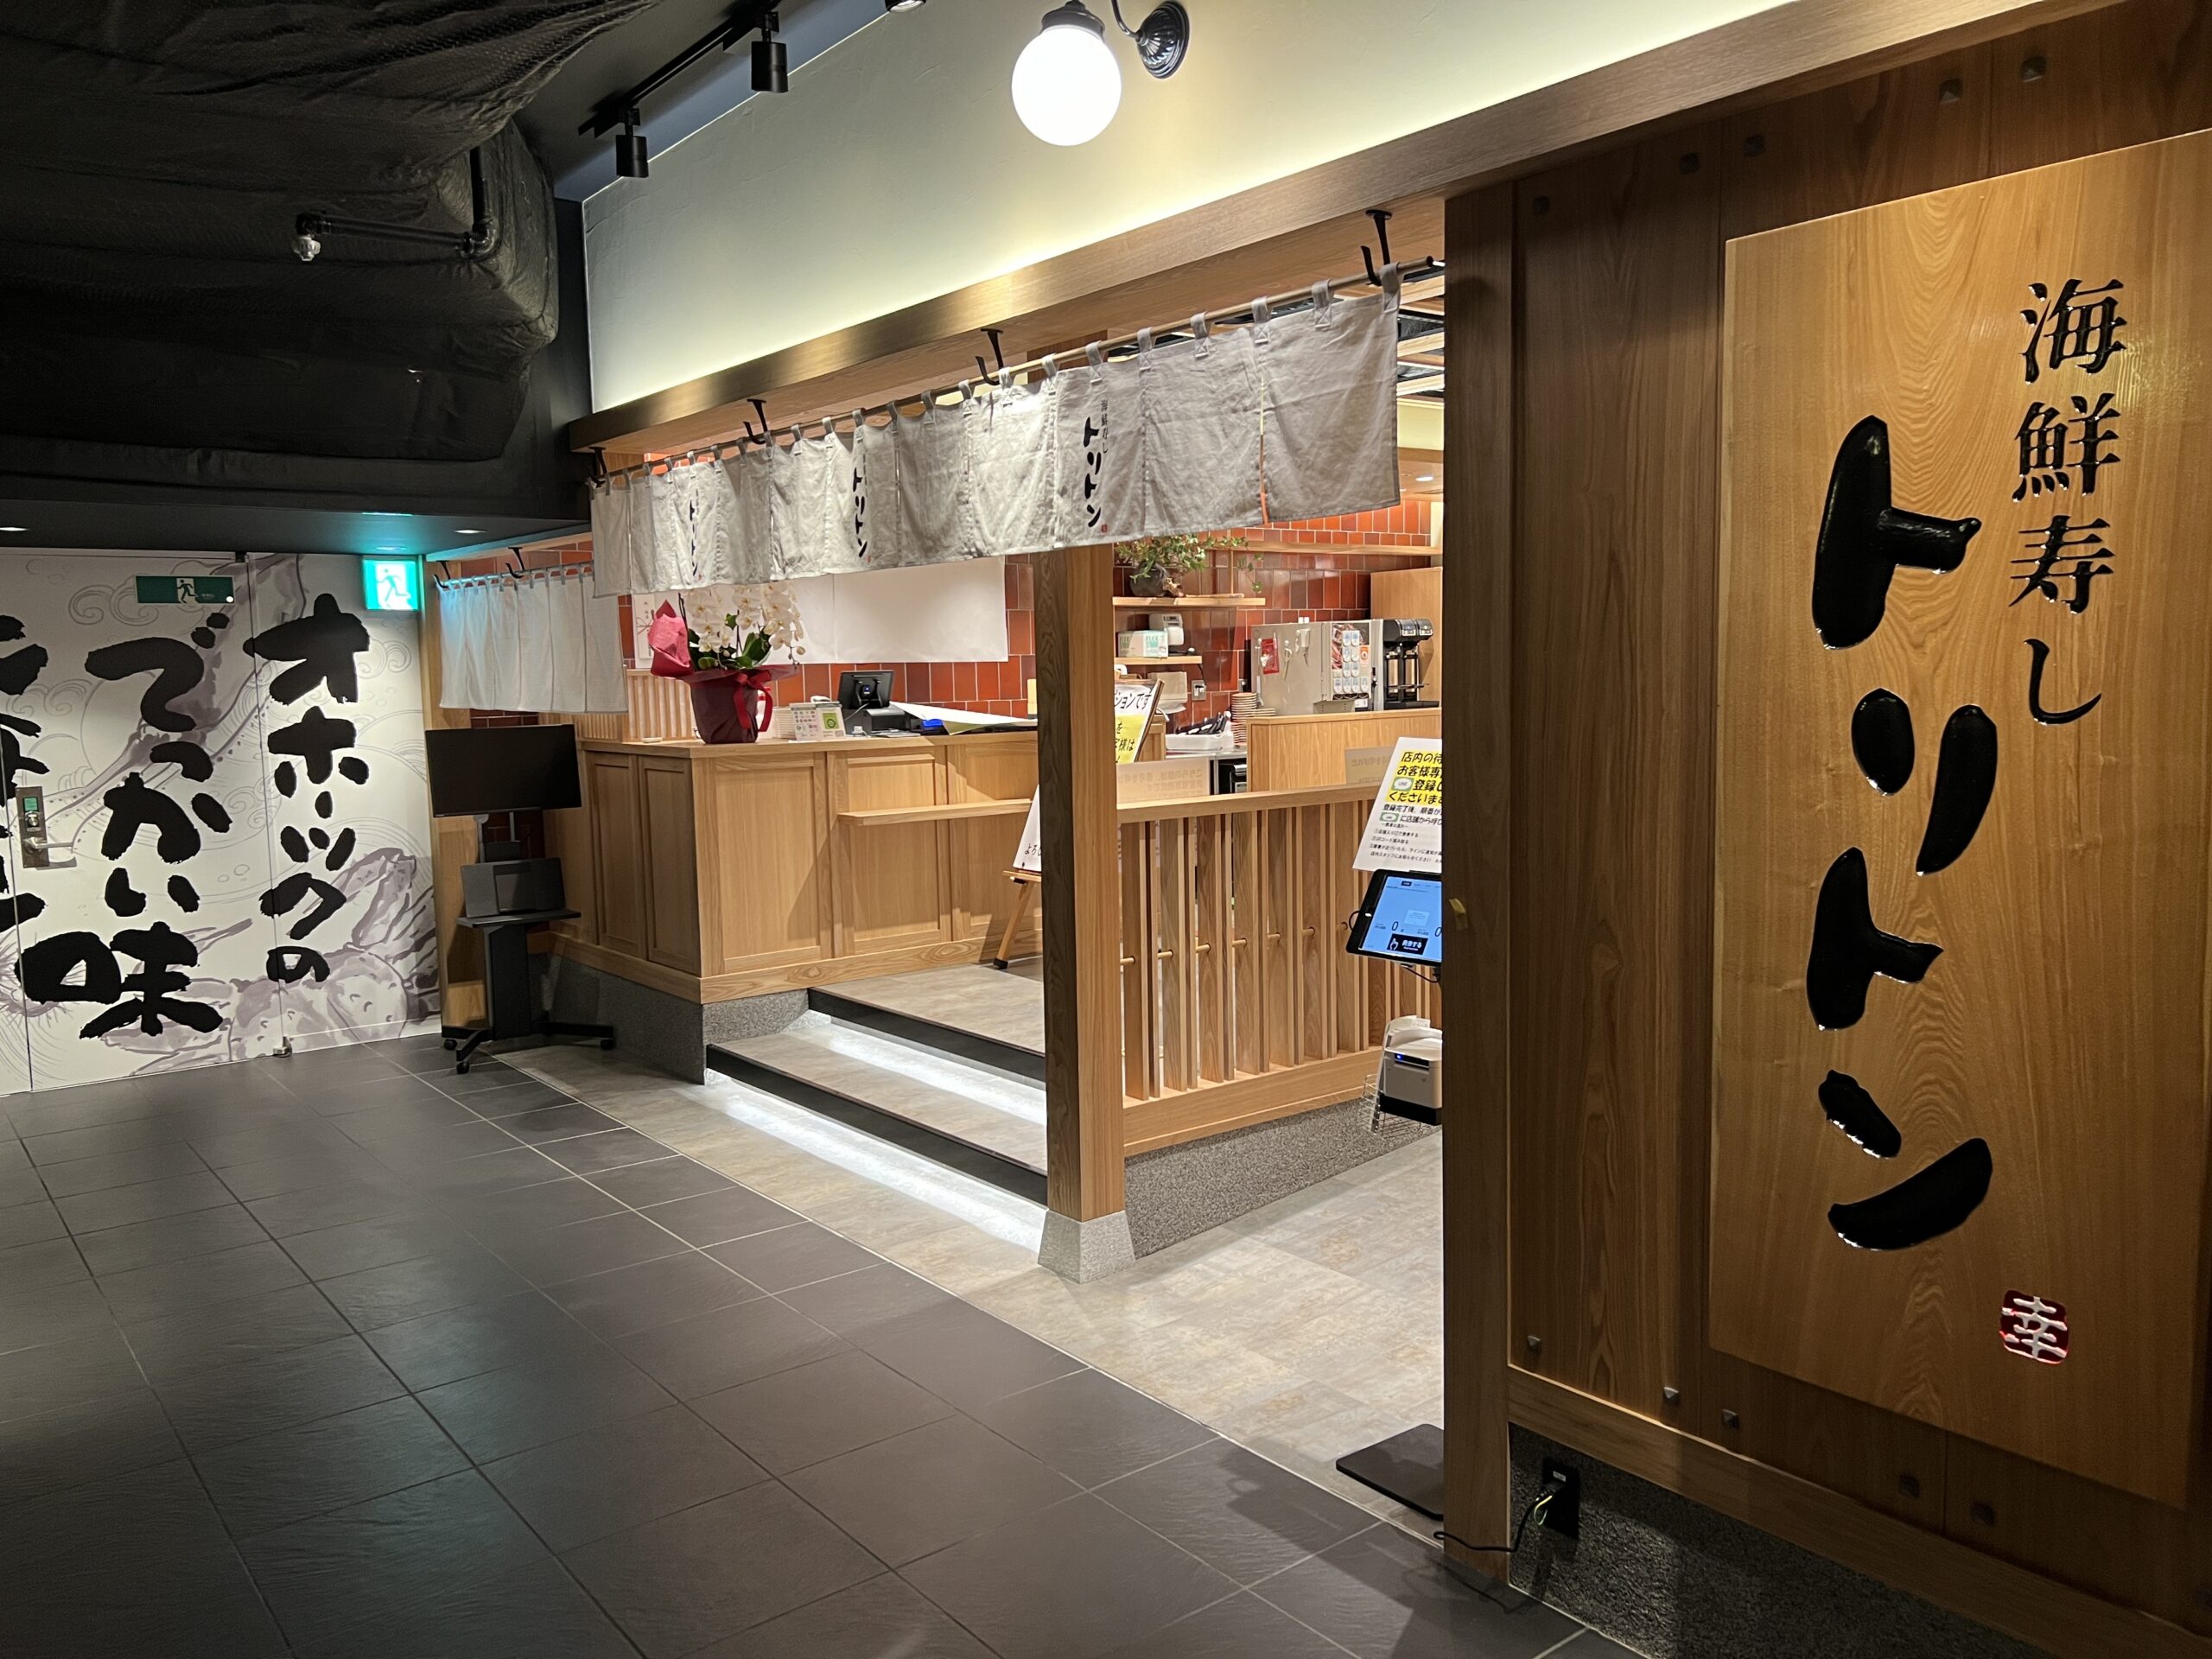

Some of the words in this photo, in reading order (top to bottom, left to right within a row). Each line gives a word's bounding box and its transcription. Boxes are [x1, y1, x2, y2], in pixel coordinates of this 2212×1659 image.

[853, 467, 868, 558] トリトン
[1083, 416, 1102, 528] トリトン
[2009, 278, 2127, 725] 海鮮寿し
[1114, 691, 1153, 710] ションです
[15, 612, 232, 1038] でっかい味
[243, 593, 370, 983] オホーツクの
[1397, 765, 1442, 779] お客様専
[1807, 415, 1998, 1250] トリトン
[1391, 921, 1399, 931] 0
